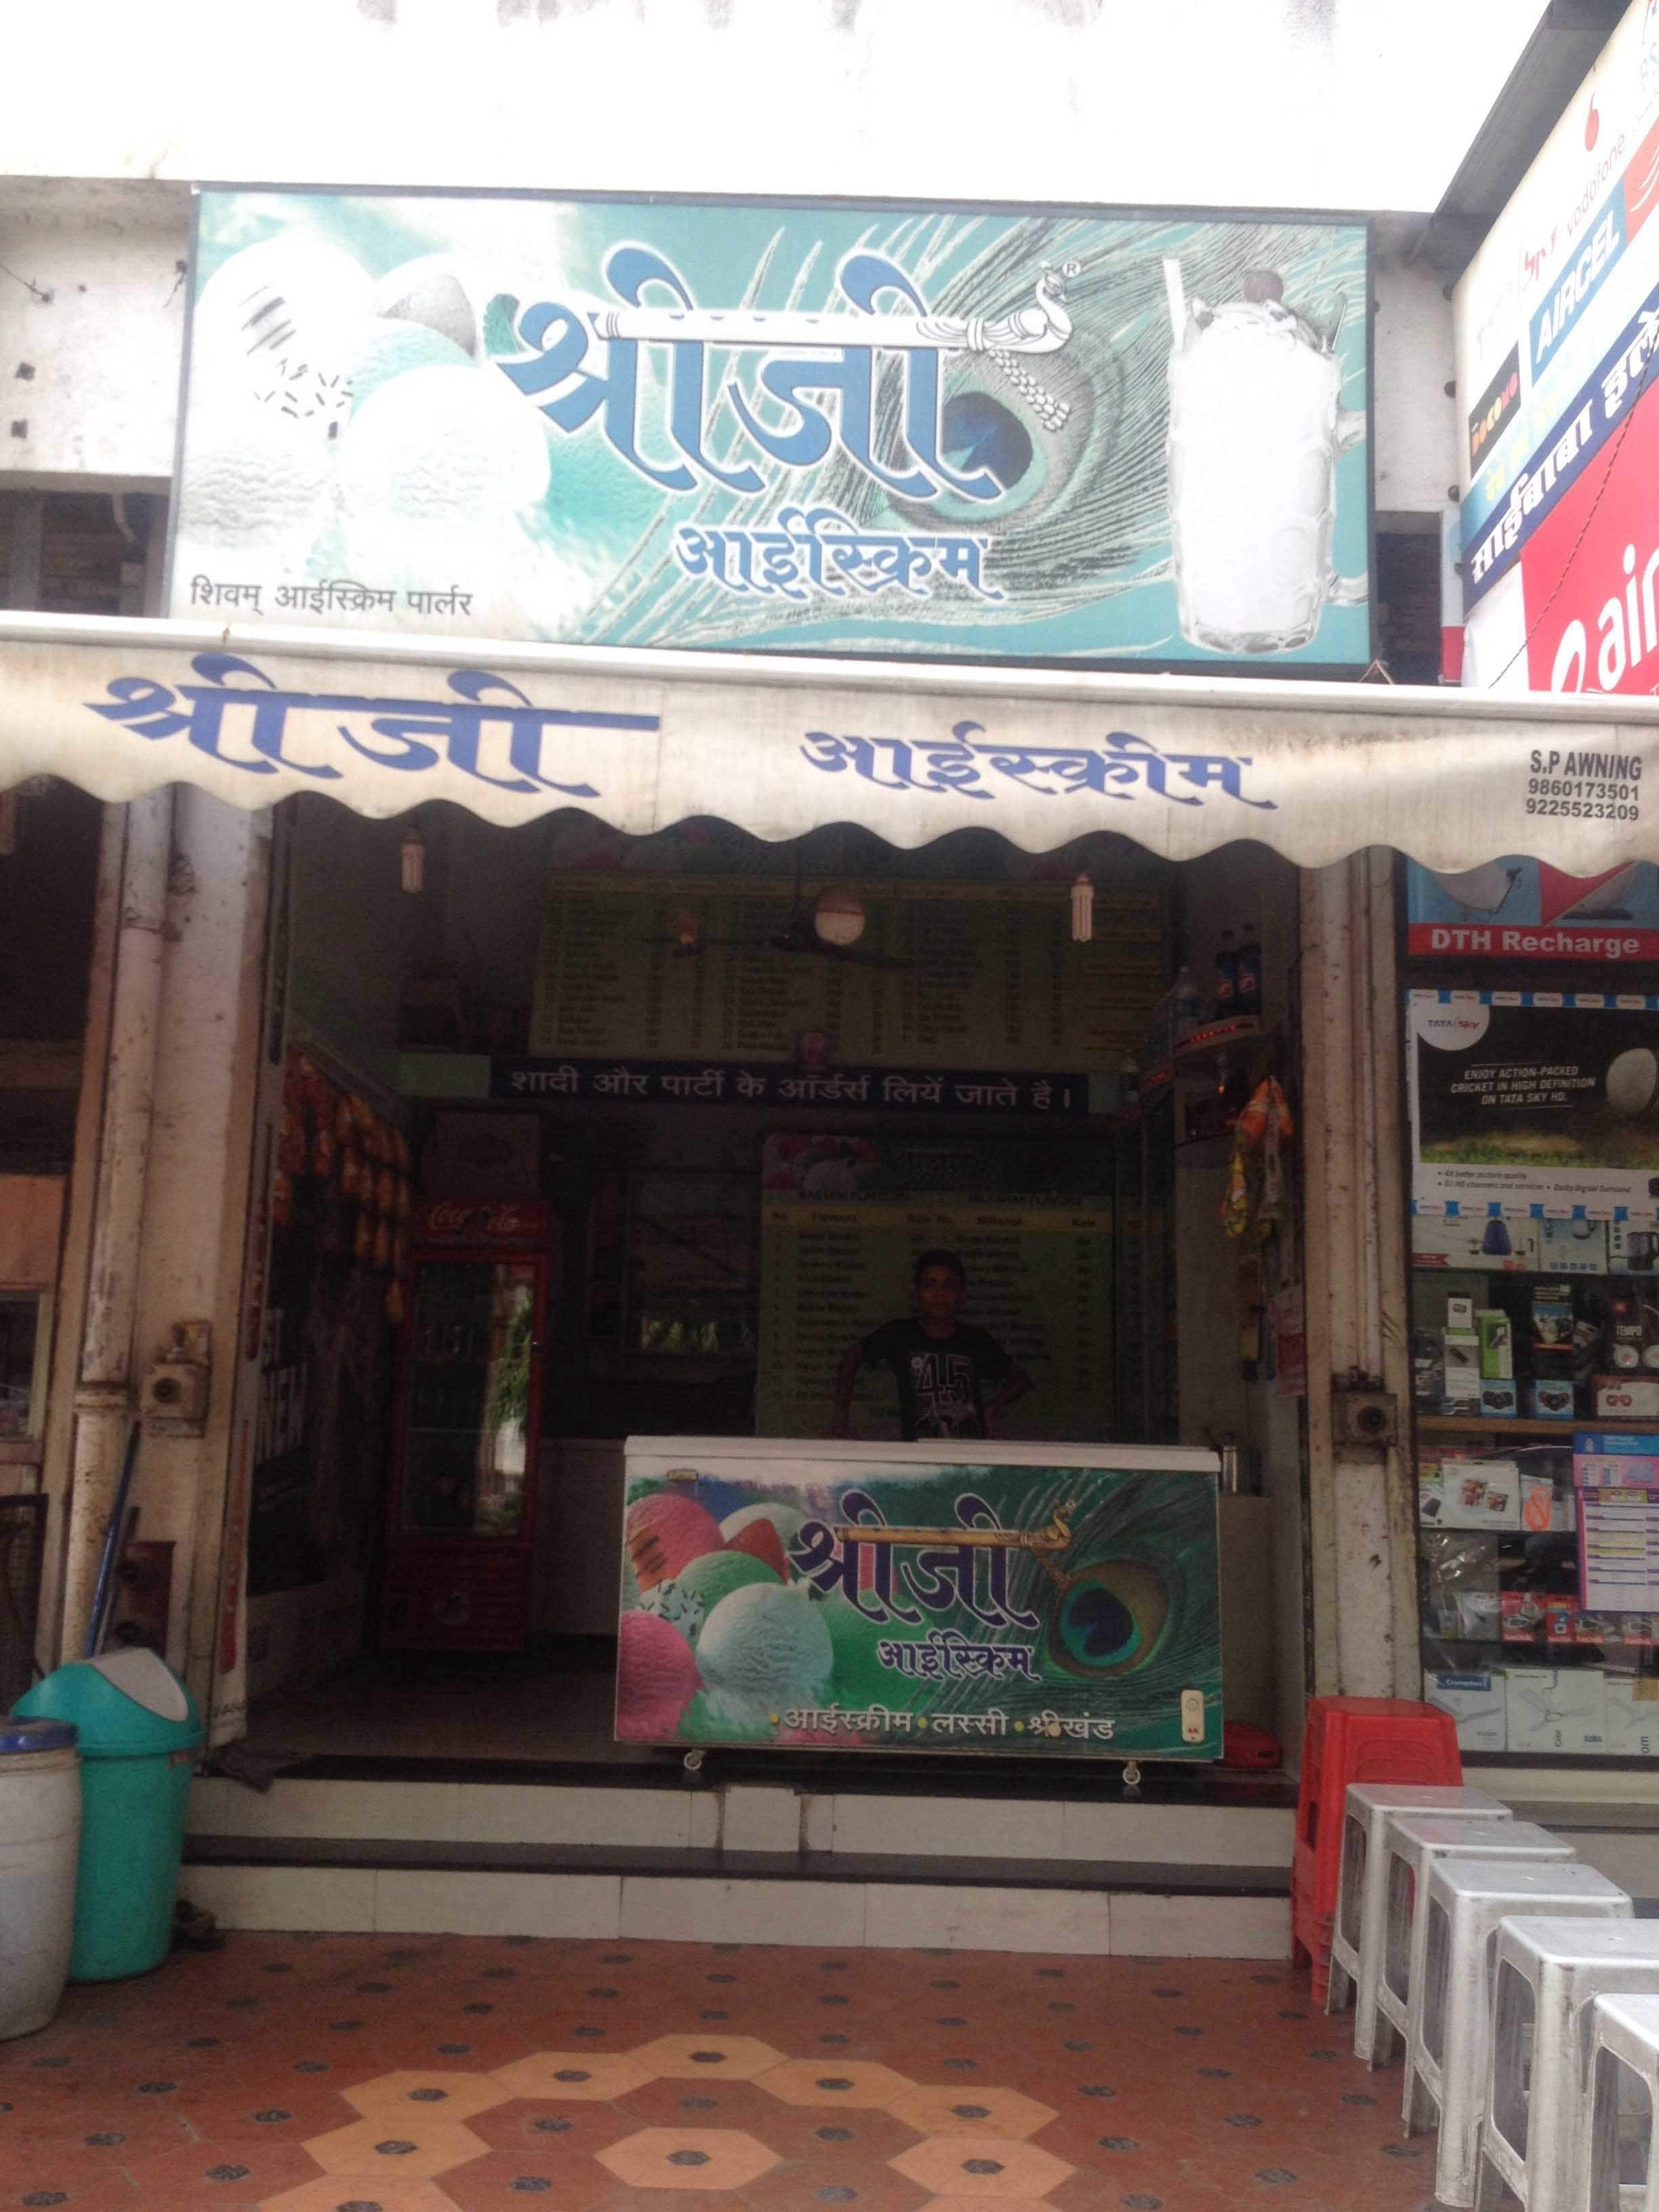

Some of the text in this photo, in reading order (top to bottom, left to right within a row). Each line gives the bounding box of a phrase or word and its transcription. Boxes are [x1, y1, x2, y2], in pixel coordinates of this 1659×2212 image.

[1567, 133, 1626, 237] vodafone
[1536, 207, 1621, 365] AIRCEL
[496, 244, 1003, 500] श्रीजी
[190, 575, 473, 616] शिवम् आईस्क्रिम पार्लर
[82, 652, 1279, 810] श्रीजी आईस्क्रीम
[1530, 750, 1642, 781] S.P AWNING
[1528, 778, 1639, 801] 9860173501
[1525, 798, 1639, 821] 9225523209
[1431, 929, 1640, 959] DTH Recharge
[510, 1065, 581, 1093] शादी
[594, 1065, 649, 1095] और
[661, 1067, 726, 1097] पार्टी
[736, 1069, 766, 1098] के
[954, 1077, 1019, 1106] जाते
[1450, 1077, 1596, 1094] CRICKET IN HIGH DEFINITION
[1465, 1066, 1578, 1080] ENJOY ACTION-PACKED
[1481, 1094, 1496, 1106] ON
[1499, 1093, 1523, 1105] TATA
[1526, 1092, 1548, 1103] SKY
[788, 1492, 1039, 1628] श्रीजी
[783, 1704, 1115, 1740] आईस्क्रीम लस्सी श्रीखंड
